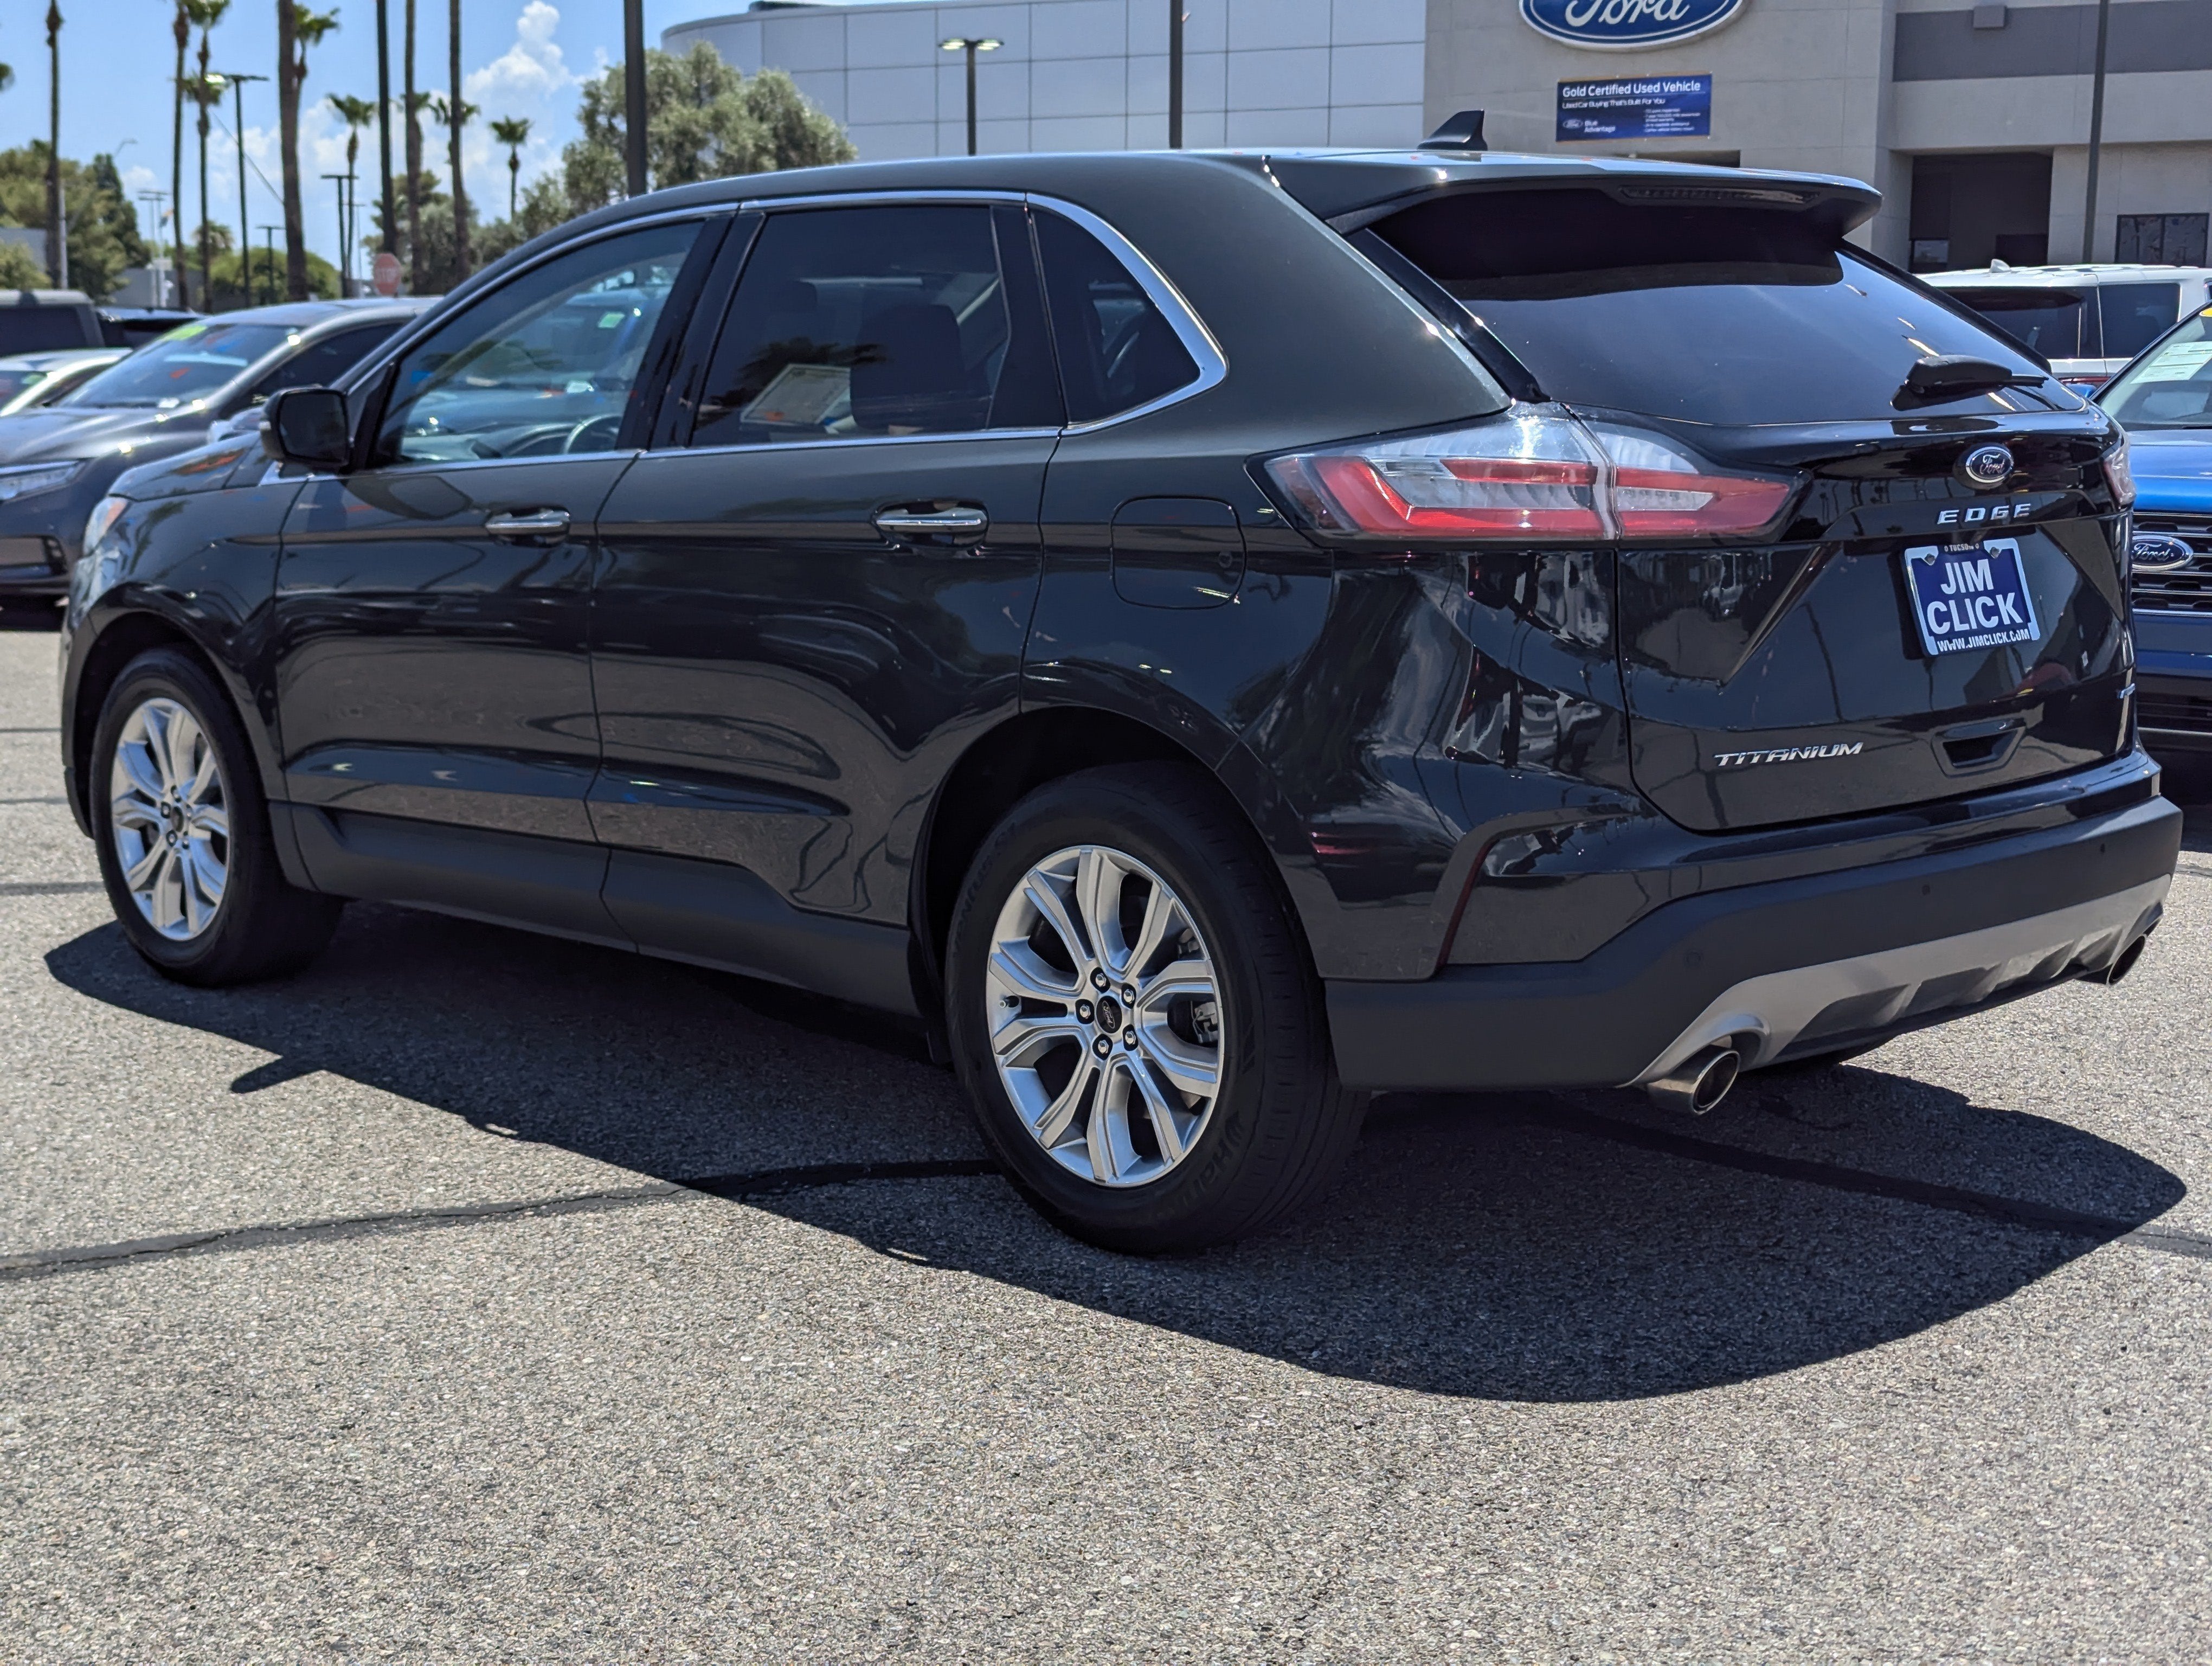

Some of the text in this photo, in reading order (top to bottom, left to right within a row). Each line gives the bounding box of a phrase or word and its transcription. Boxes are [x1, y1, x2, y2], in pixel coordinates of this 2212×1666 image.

[1562, 80, 1701, 98] Gold Certified Used Vehicle
[1979, 452, 2005, 475] Ford
[1937, 503, 2031, 524] EDGE
[2131, 542, 2170, 561] Ford
[1940, 559, 1994, 594] JIM
[1927, 592, 2023, 635] CLICK
[1714, 742, 1864, 766] TITANIUM
